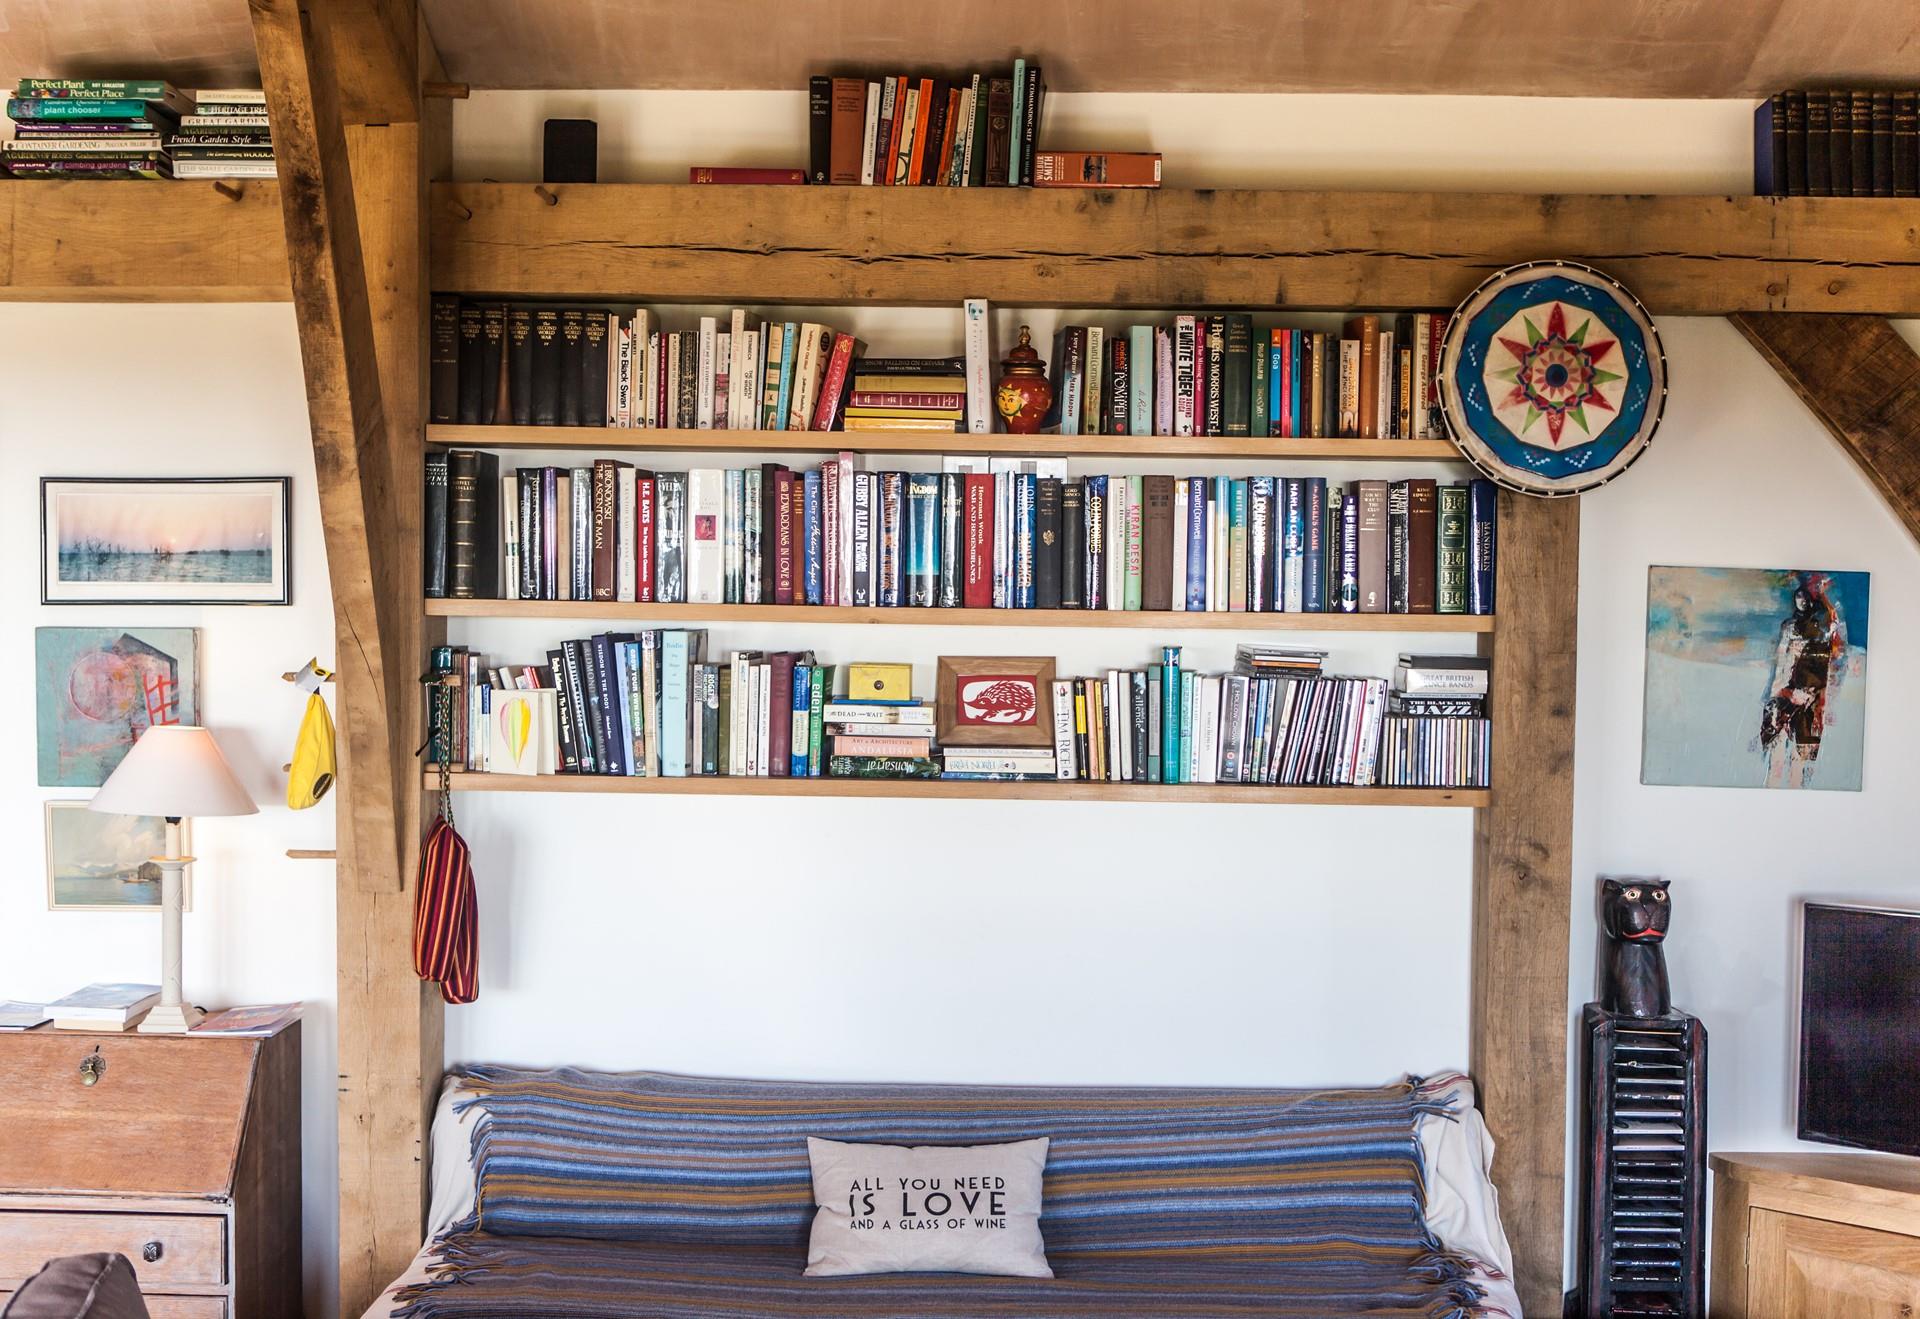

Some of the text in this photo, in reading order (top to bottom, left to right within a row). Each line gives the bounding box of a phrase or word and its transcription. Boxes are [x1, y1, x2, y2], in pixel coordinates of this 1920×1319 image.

[31, 80, 85, 91] Perfect Plant
[1029, 70, 1037, 83] THE
[70, 90, 125, 100] Perfect Place
[1026, 83, 1035, 127] COMMANDING
[44, 105, 101, 115] plant chooser
[16, 141, 101, 150] CONTAINER GARDENING
[171, 134, 256, 146] French Garden Style
[65, 161, 127, 171] climbing gardens
[1036, 156, 1044, 181] WILBUR
[1043, 156, 1053, 182] SMITH
[1089, 331, 1100, 392] Bernard Cornwell
[1178, 332, 1194, 398] WHITE TIGER
[1196, 357, 1204, 379] Missing
[1210, 323, 1224, 426] Proteus MORRIS WEST
[1256, 343, 1265, 380] PHILIP PULLMAN
[1272, 353, 1280, 370] Goa
[1342, 364, 1348, 373] DA
[620, 342, 630, 409] The Black Swan
[1068, 376, 1077, 392] MARK
[1113, 372, 1126, 418] POMPEII
[1420, 381, 1428, 410] Axelrod
[604, 469, 612, 520] BRONOWSKI
[642, 482, 650, 498] H.E.
[1017, 478, 1025, 520] GRISHAM
[1390, 488, 1399, 515] SMITH
[1400, 488, 1408, 514] WILBUR
[595, 464, 604, 549] THE ASCENT OF MAN
[642, 499, 650, 524] BATES
[780, 493, 790, 546] EDWARDIANS
[827, 465, 838, 570] ROMANTIC ENGLAND
[855, 474, 869, 541] GUBBY ALLEN
[1193, 480, 1203, 540] Bernard Cornwell
[1090, 496, 1102, 554] COLIN FORBES
[1235, 515, 1243, 536] TEETH
[1289, 483, 1299, 557] HARLAN COBEN
[1311, 493, 1320, 551] ANGEL'S GAME
[1394, 525, 1402, 536] THE
[808, 485, 821, 586] The City of Falling Angels
[1130, 504, 1140, 577] KIRAN DESAI
[1344, 523, 1357, 572] BELLINI CARD
[1394, 536, 1402, 559] SEVENTH
[1483, 521, 1491, 572] MANDARIN
[969, 523, 977, 585] REMEMBRANCE
[641, 559, 649, 582] Chronicles
[780, 557, 790, 579] LOVE
[595, 587, 610, 597] BBC
[597, 643, 605, 669] WISDOM
[583, 647, 596, 693] REDMOND
[600, 670, 606, 678] IN
[630, 648, 641, 737] GROW YOUR OWN DRUGS
[560, 707, 568, 725] Persian
[811, 683, 823, 747] eden TIM SMIT
[1135, 695, 1143, 729] allende
[1231, 689, 1241, 746] HOLLOW CROWN
[1409, 705, 1472, 715] JAZZ
[1058, 709, 1071, 765] TIM RICE
[867, 760, 914, 774] Monsarrat
[850, 1176, 1005, 1192] ALL YOU NEED
[849, 1191, 1006, 1217] IS LOVE
[850, 1218, 1007, 1230] AND A GLASS OF WINE
